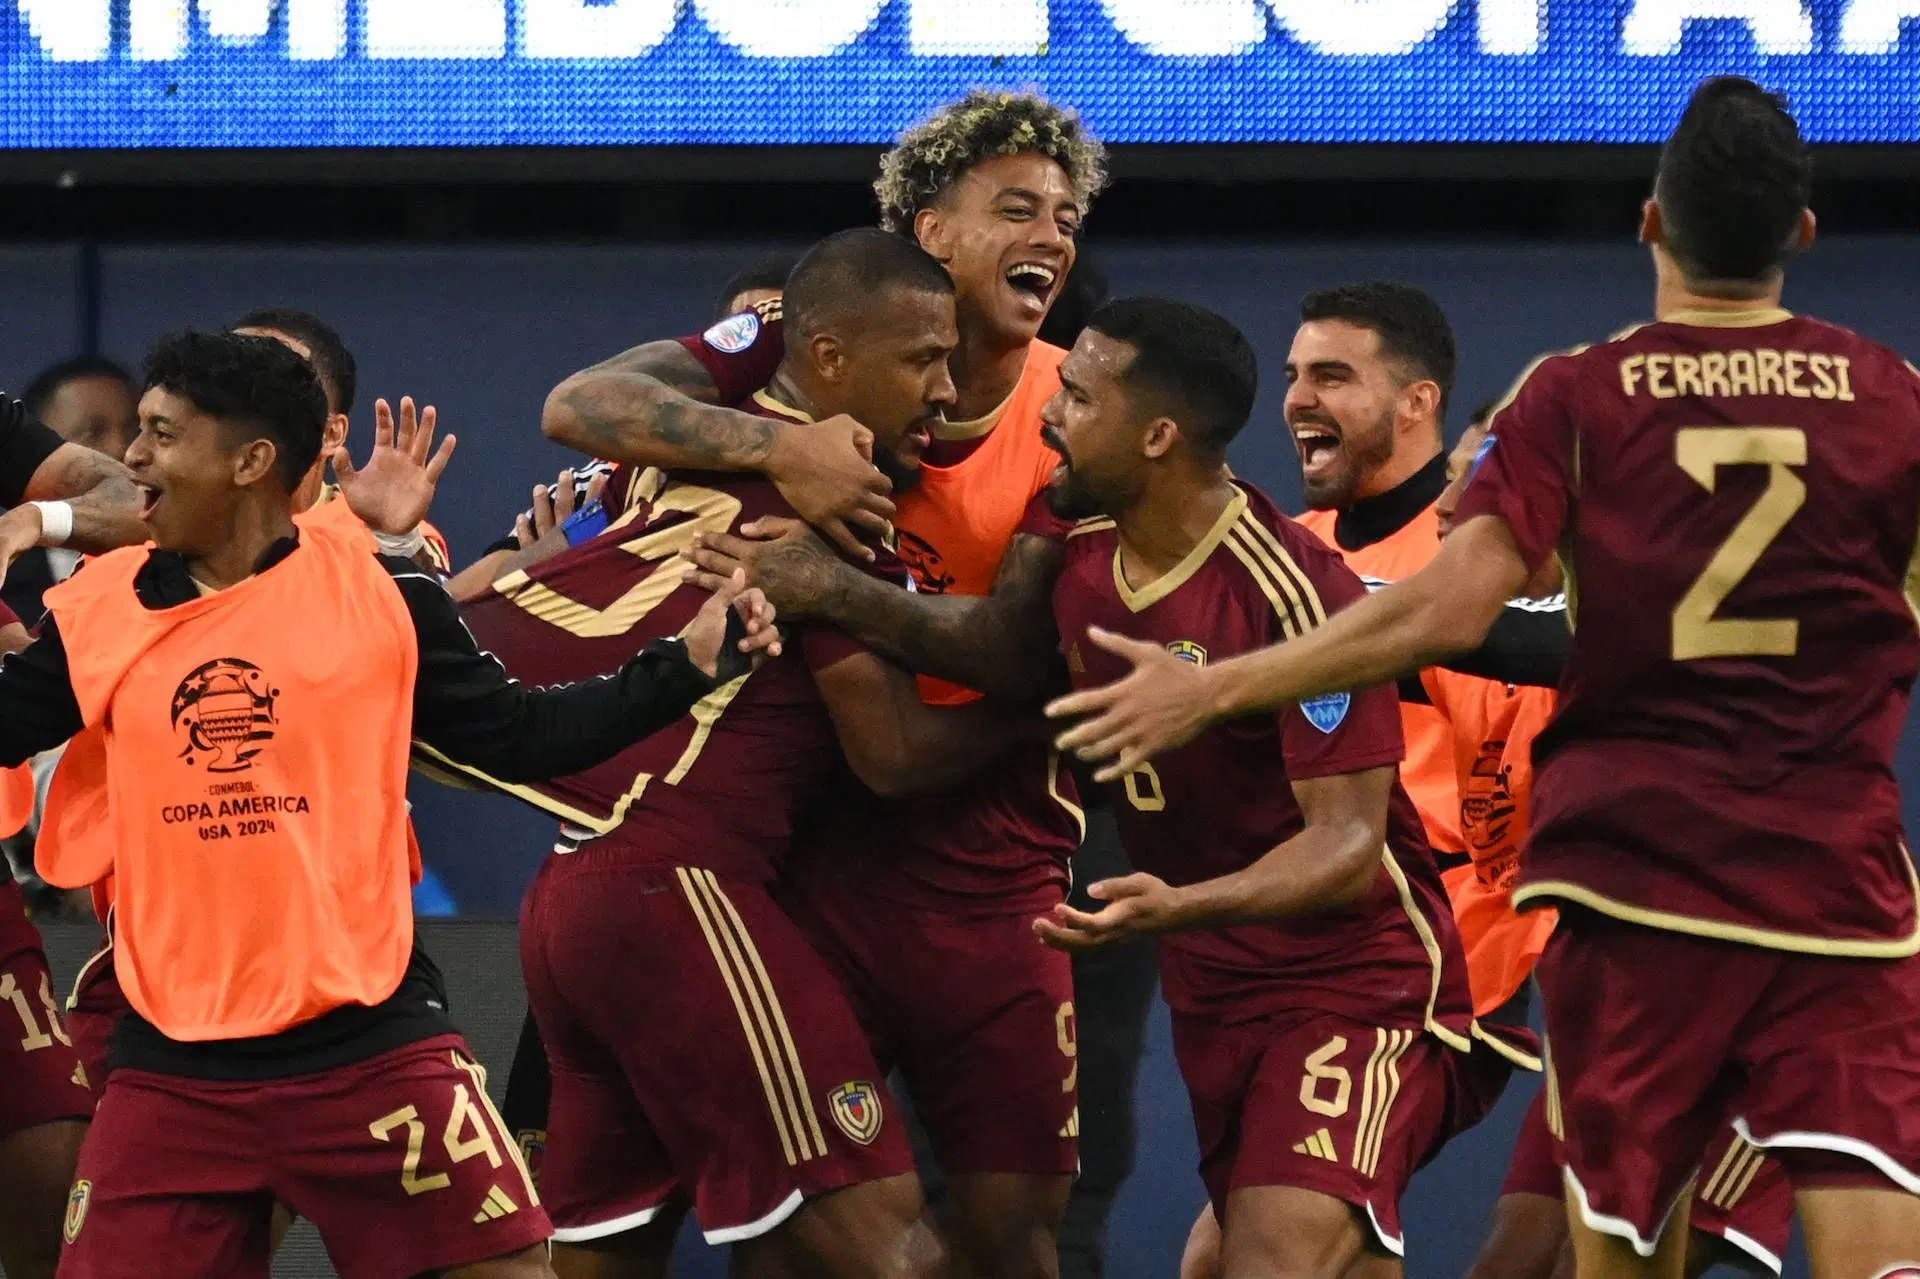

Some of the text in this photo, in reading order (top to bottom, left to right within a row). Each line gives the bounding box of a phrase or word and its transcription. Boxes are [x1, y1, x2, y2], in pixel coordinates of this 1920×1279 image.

[1619, 348, 1855, 401] FERRARESI
[1672, 427, 1808, 661] 2
[162, 796, 310, 824] COPA AMERICA
[208, 781, 255, 796] CONMEBOL
[199, 819, 275, 841] USA 2024
[1299, 1035, 1352, 1118] 6
[368, 1083, 503, 1196] 24
